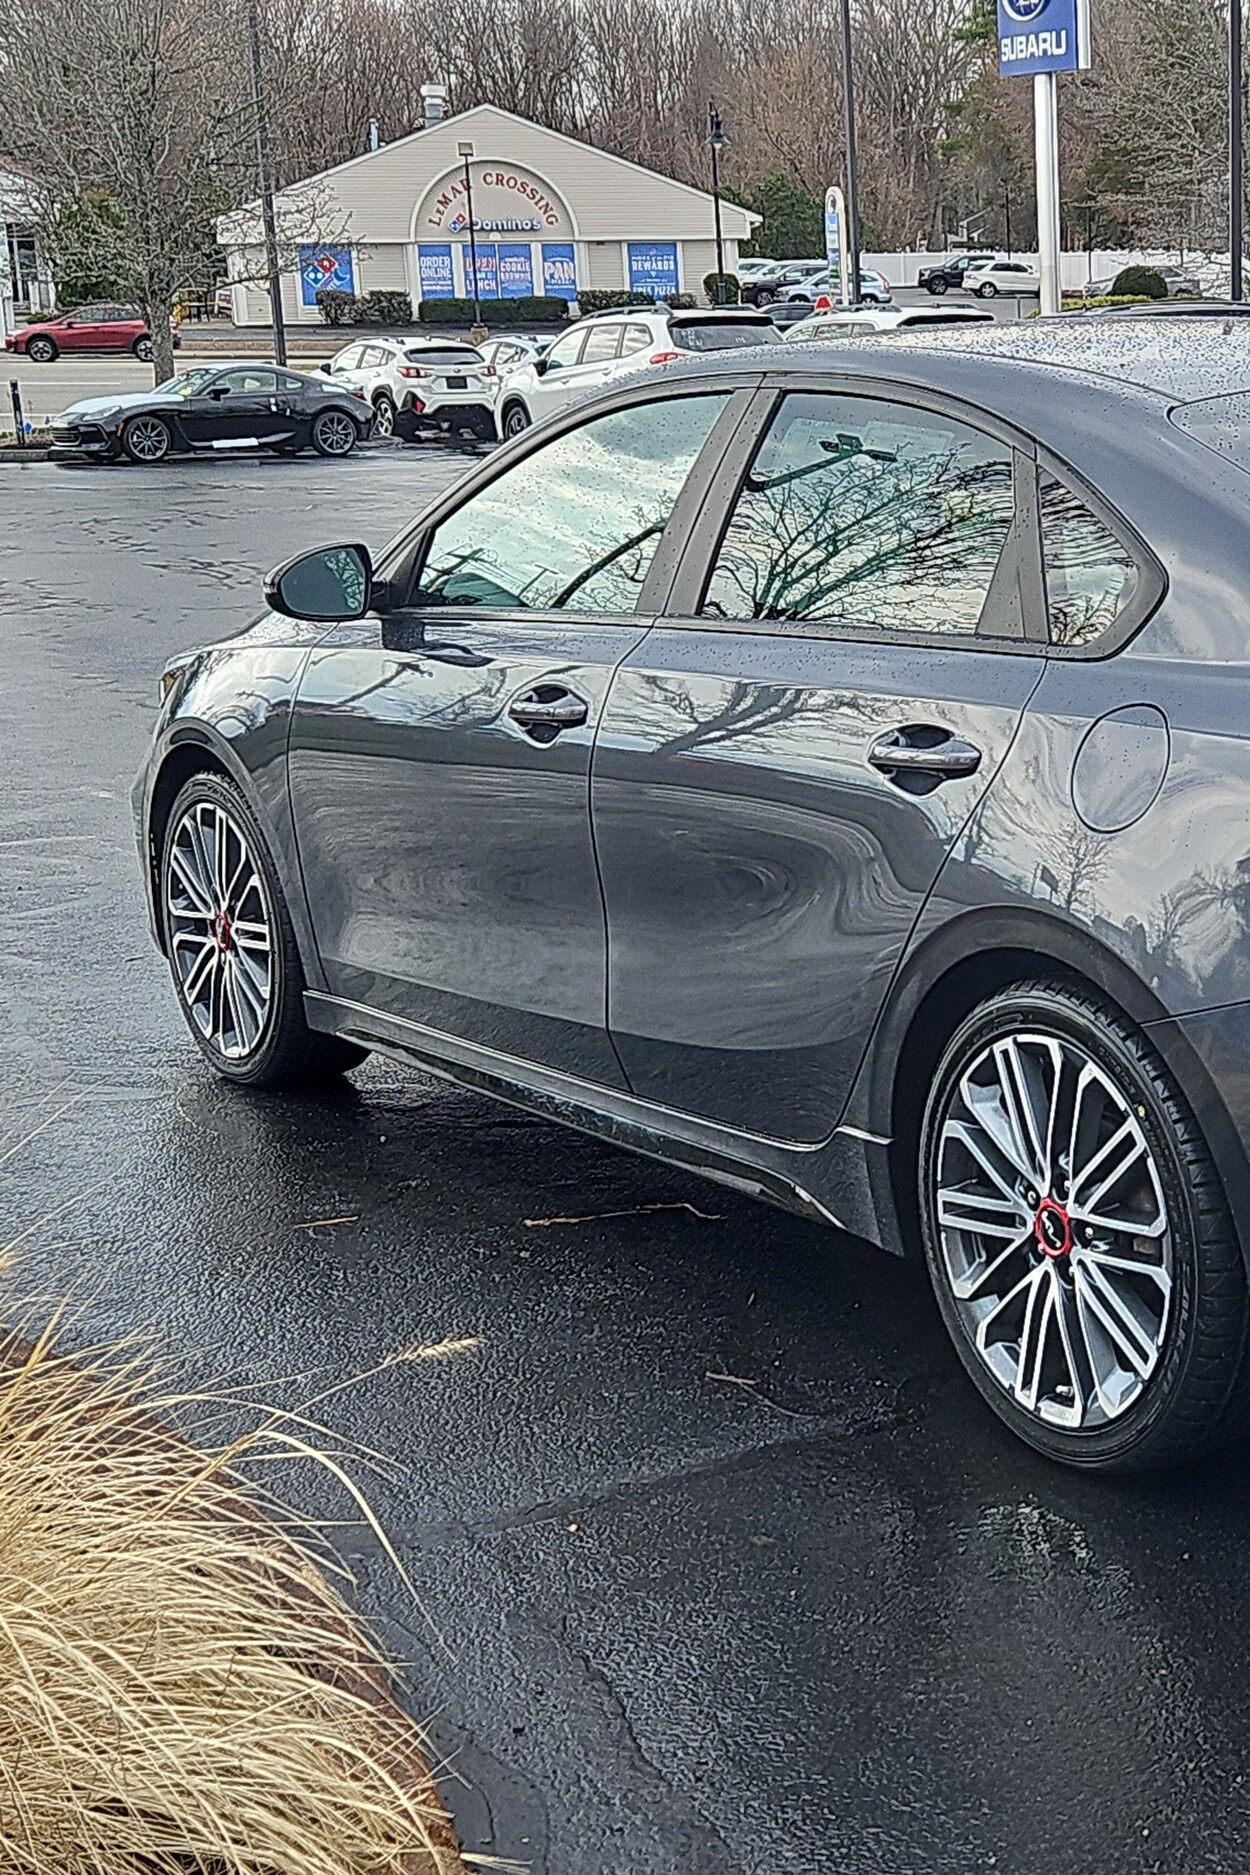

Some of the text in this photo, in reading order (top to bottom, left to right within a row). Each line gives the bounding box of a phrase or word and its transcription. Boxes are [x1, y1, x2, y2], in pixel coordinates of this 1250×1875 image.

[1001, 29, 1066, 62] SUBARU
[482, 172, 559, 227] CROSSING
[472, 217, 542, 231] Domino's
[420, 256, 451, 268] ORDER
[500, 262, 531, 271] COOKIE
[631, 261, 675, 271] REWARDS
[421, 268, 452, 278] ONLINE
[544, 261, 575, 280] PAN
